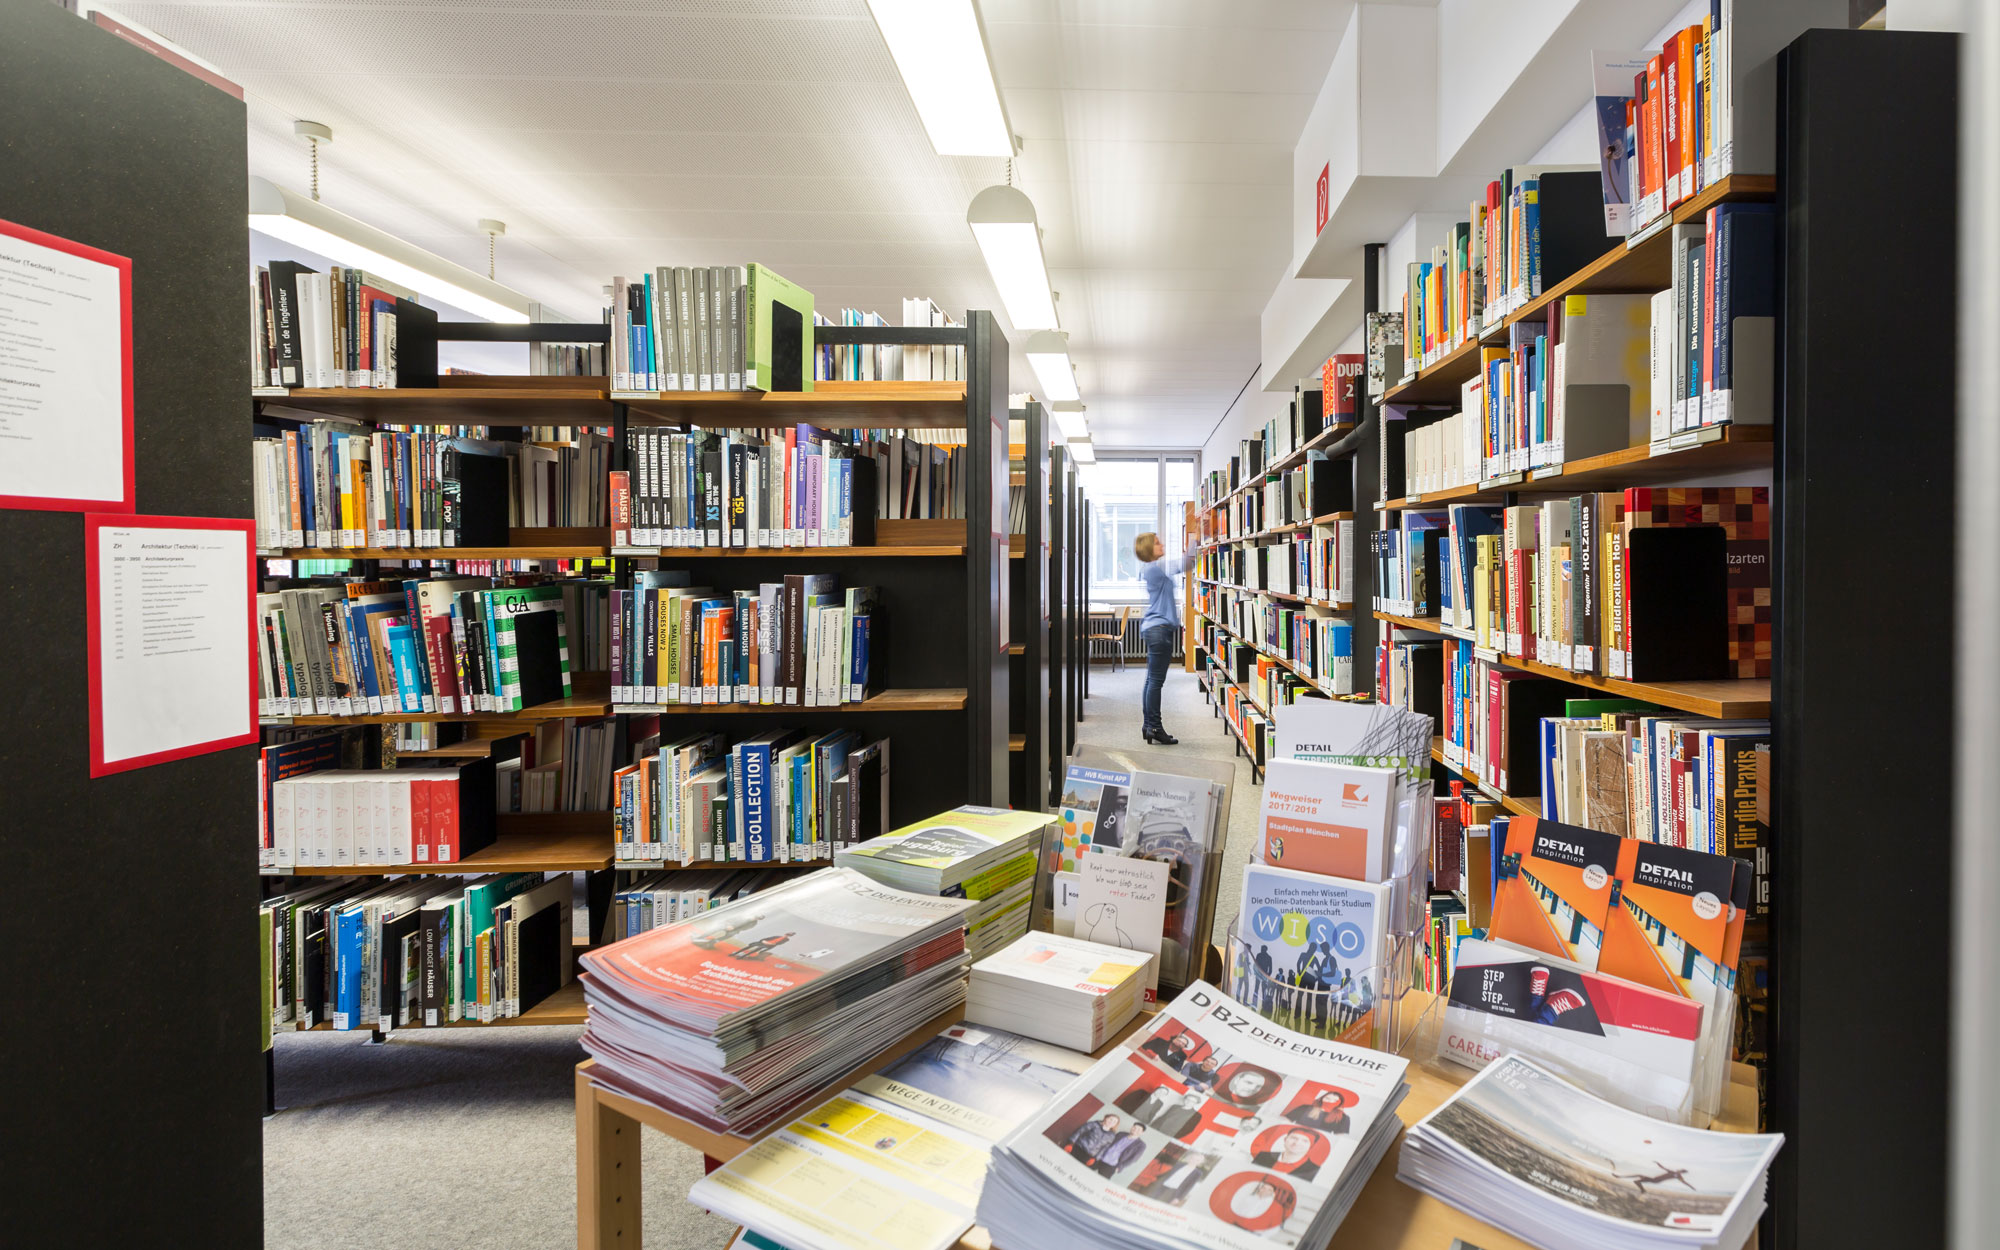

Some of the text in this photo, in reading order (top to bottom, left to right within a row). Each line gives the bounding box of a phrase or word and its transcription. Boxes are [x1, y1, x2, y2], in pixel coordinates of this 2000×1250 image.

[1667, 61, 1676, 142] Windkraftanlagen
[663, 290, 672, 321] WOHNEN
[681, 290, 689, 321] WOHNEN
[1691, 258, 1699, 333] Kunstschlosserei
[278, 287, 292, 359] l'art de l'ingénieur
[1690, 360, 1698, 397] Metzger
[1345, 384, 1354, 397] 2
[289, 446, 298, 482] Penthouse
[638, 434, 648, 497] EINFAMILIENHÄUSER
[649, 434, 659, 497] EINFAMILIENHÄUSER
[660, 435, 671, 498] EINFAMILIENHÄUSER
[672, 450, 680, 466] HOLZ
[443, 499, 452, 523] APOP
[619, 488, 628, 524] HÄUSER
[706, 506, 720, 521] XS
[734, 495, 745, 514] 150
[1582, 506, 1590, 571] HOLZatlas
[1726, 553, 1766, 565] lzarten
[1612, 533, 1622, 633] Bildlexikon Holz
[505, 594, 530, 614] GA
[324, 611, 335, 642] Housing
[741, 608, 749, 631] URBAN
[760, 604, 770, 655] HOUSES
[295, 662, 309, 698] typolog
[1295, 743, 1333, 752] DETAIL
[1084, 770, 1127, 783] HVB Kunst APP
[1660, 736, 1668, 824] HOLZSCHUTZPRAXIS
[701, 785, 709, 802] MINI
[746, 752, 763, 845] COLLECTION
[1269, 791, 1323, 805] Wegweiser
[1677, 774, 1685, 822] Holzschutz
[1734, 750, 1758, 849] Für die Praxis
[1268, 801, 1318, 815] 2017/2018
[1269, 822, 1340, 839] Stadtplan München
[1536, 847, 1584, 864] inspiration
[1537, 836, 1585, 858] DETAIL
[1638, 873, 1693, 891] inspiration
[1639, 862, 1694, 885] DETAIL
[870, 891, 961, 910] DER ENTWURF
[1251, 897, 1372, 908] Die Online-Datenbank für Studium
[1273, 888, 1348, 898] Einfach mehr Wissen!
[1280, 907, 1344, 917] und Wissenschaft.
[1257, 912, 1359, 952] WISO
[426, 944, 434, 969] BUDGET
[1482, 980, 1494, 992] BY
[1483, 968, 1505, 982] STEP
[1250, 1026, 1286, 1048] DER
[1290, 1043, 1389, 1072] ENTWURF
[1495, 1071, 1527, 1091] STEP
[1509, 1060, 1540, 1080] STEP
[886, 1082, 961, 1114] WEGE IN DIE
